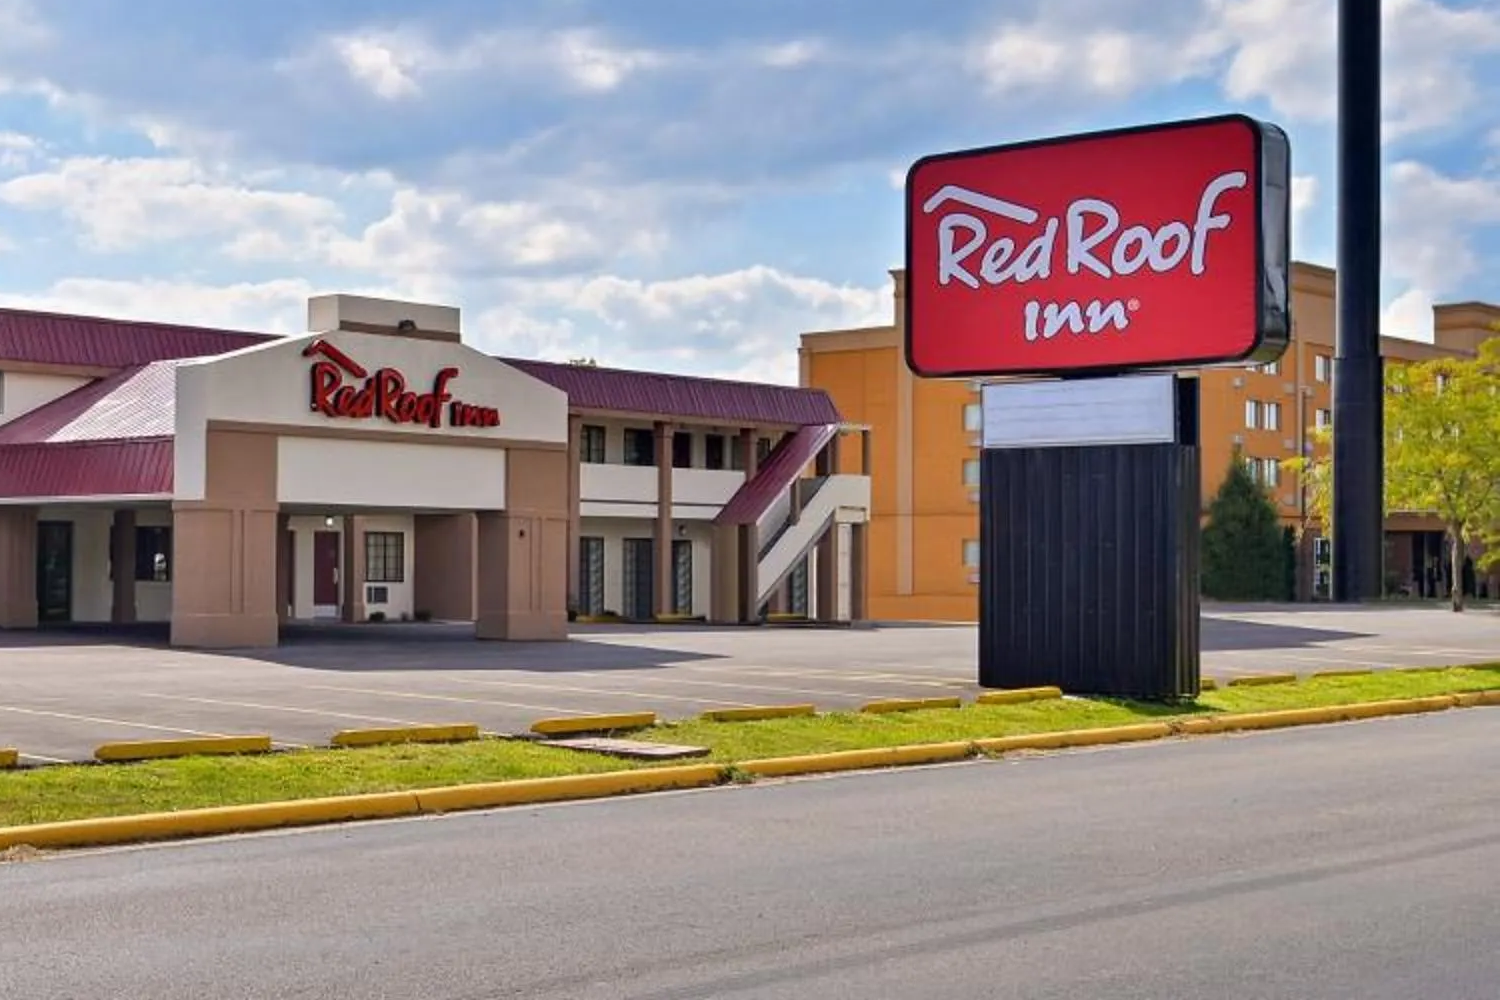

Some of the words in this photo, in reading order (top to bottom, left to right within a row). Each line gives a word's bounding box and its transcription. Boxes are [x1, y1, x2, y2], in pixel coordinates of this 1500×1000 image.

[938, 214, 1059, 289] Red
[1066, 171, 1247, 279] Roof
[310, 361, 374, 418] Red
[374, 367, 460, 428] Roof
